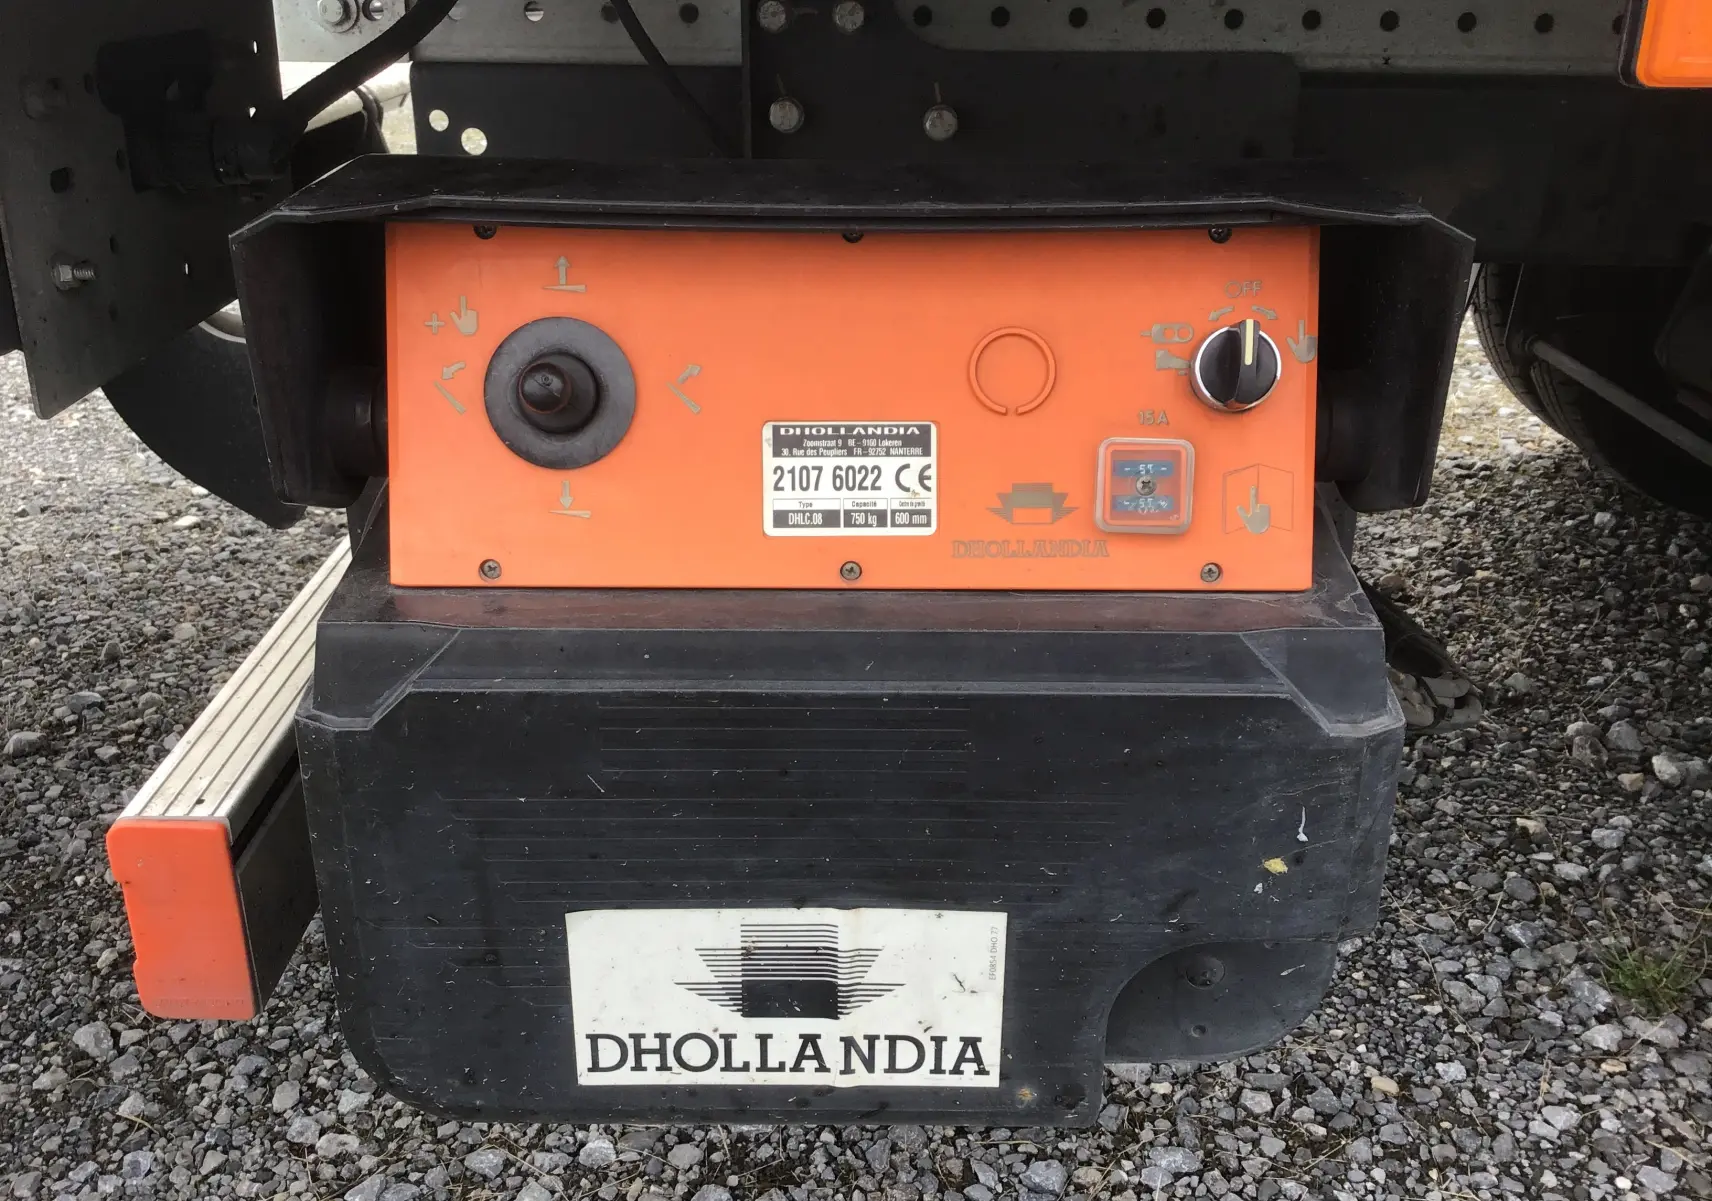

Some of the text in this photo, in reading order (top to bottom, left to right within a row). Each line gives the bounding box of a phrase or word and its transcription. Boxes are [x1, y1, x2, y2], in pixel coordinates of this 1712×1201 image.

[1224, 281, 1262, 298] OFF
[1138, 410, 1169, 425] 15A
[780, 426, 920, 436] DHOLLANDIA
[803, 439, 836, 447] Zoomstraat
[837, 439, 842, 447] 9
[862, 439, 877, 447] 9160
[878, 439, 903, 447] Lokeren
[792, 448, 805, 456] Rue
[806, 448, 817, 456] des
[819, 448, 847, 457] Peupliers
[889, 447, 923, 456] NANTERRE
[773, 463, 932, 493] 2107 6022 CE
[788, 512, 823, 525] DHLC.08
[850, 512, 877, 527] 750 kg
[895, 512, 927, 525] 600 mm
[952, 540, 1110, 558] DHOLLANDIA
[586, 1032, 991, 1076] DHOLLANDIA
